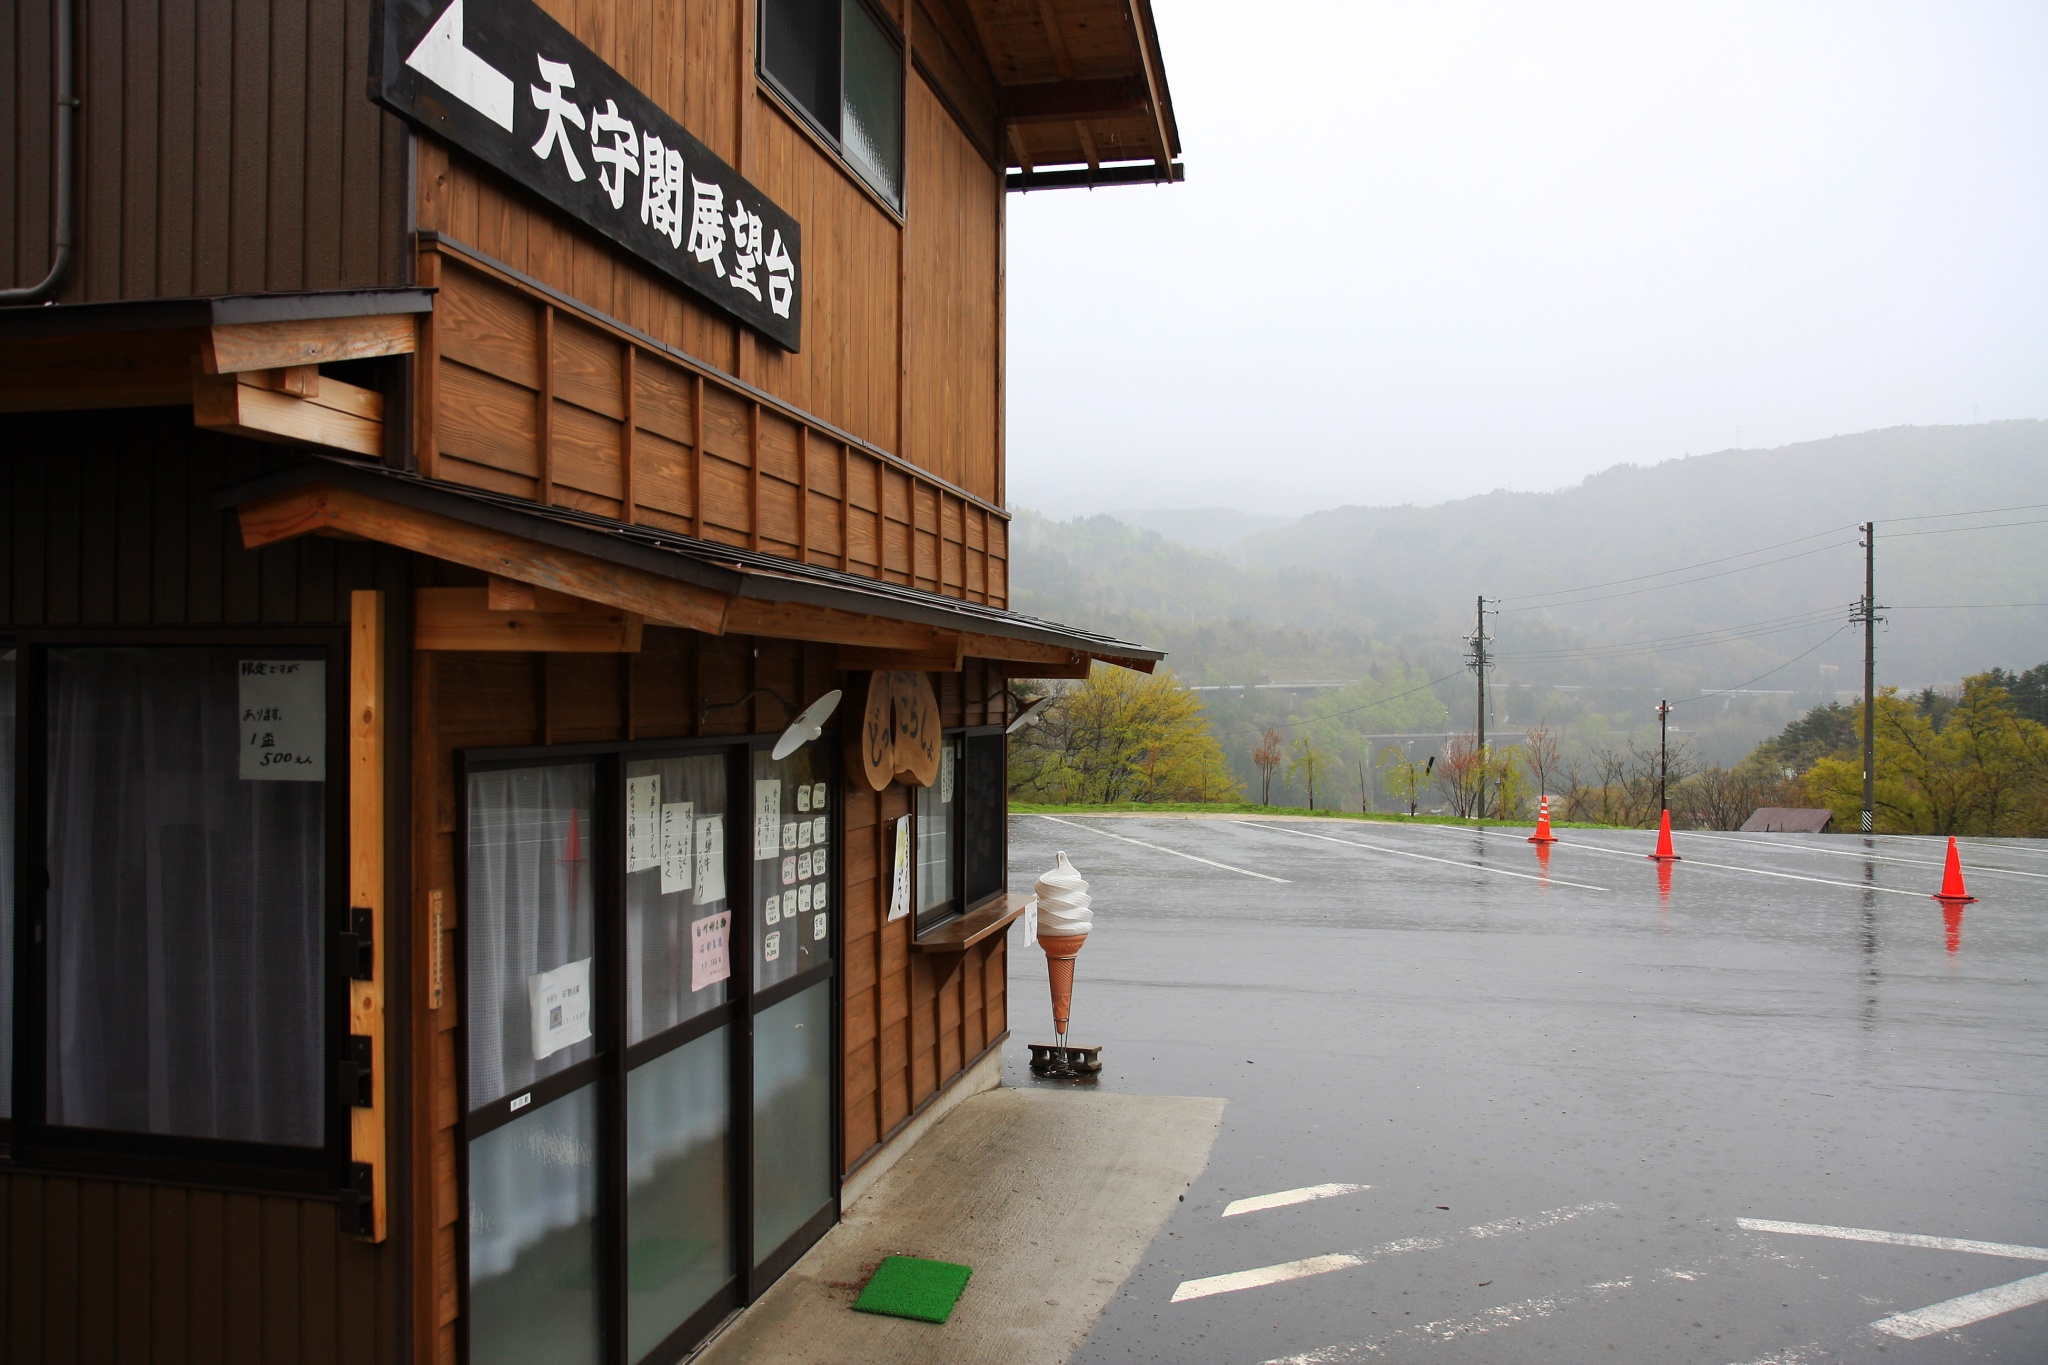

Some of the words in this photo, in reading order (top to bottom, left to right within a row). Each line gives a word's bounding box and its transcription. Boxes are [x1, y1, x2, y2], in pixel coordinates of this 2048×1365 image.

[530, 53, 795, 320] 天守閣展望台
[241, 662, 300, 676] 限定ですが
